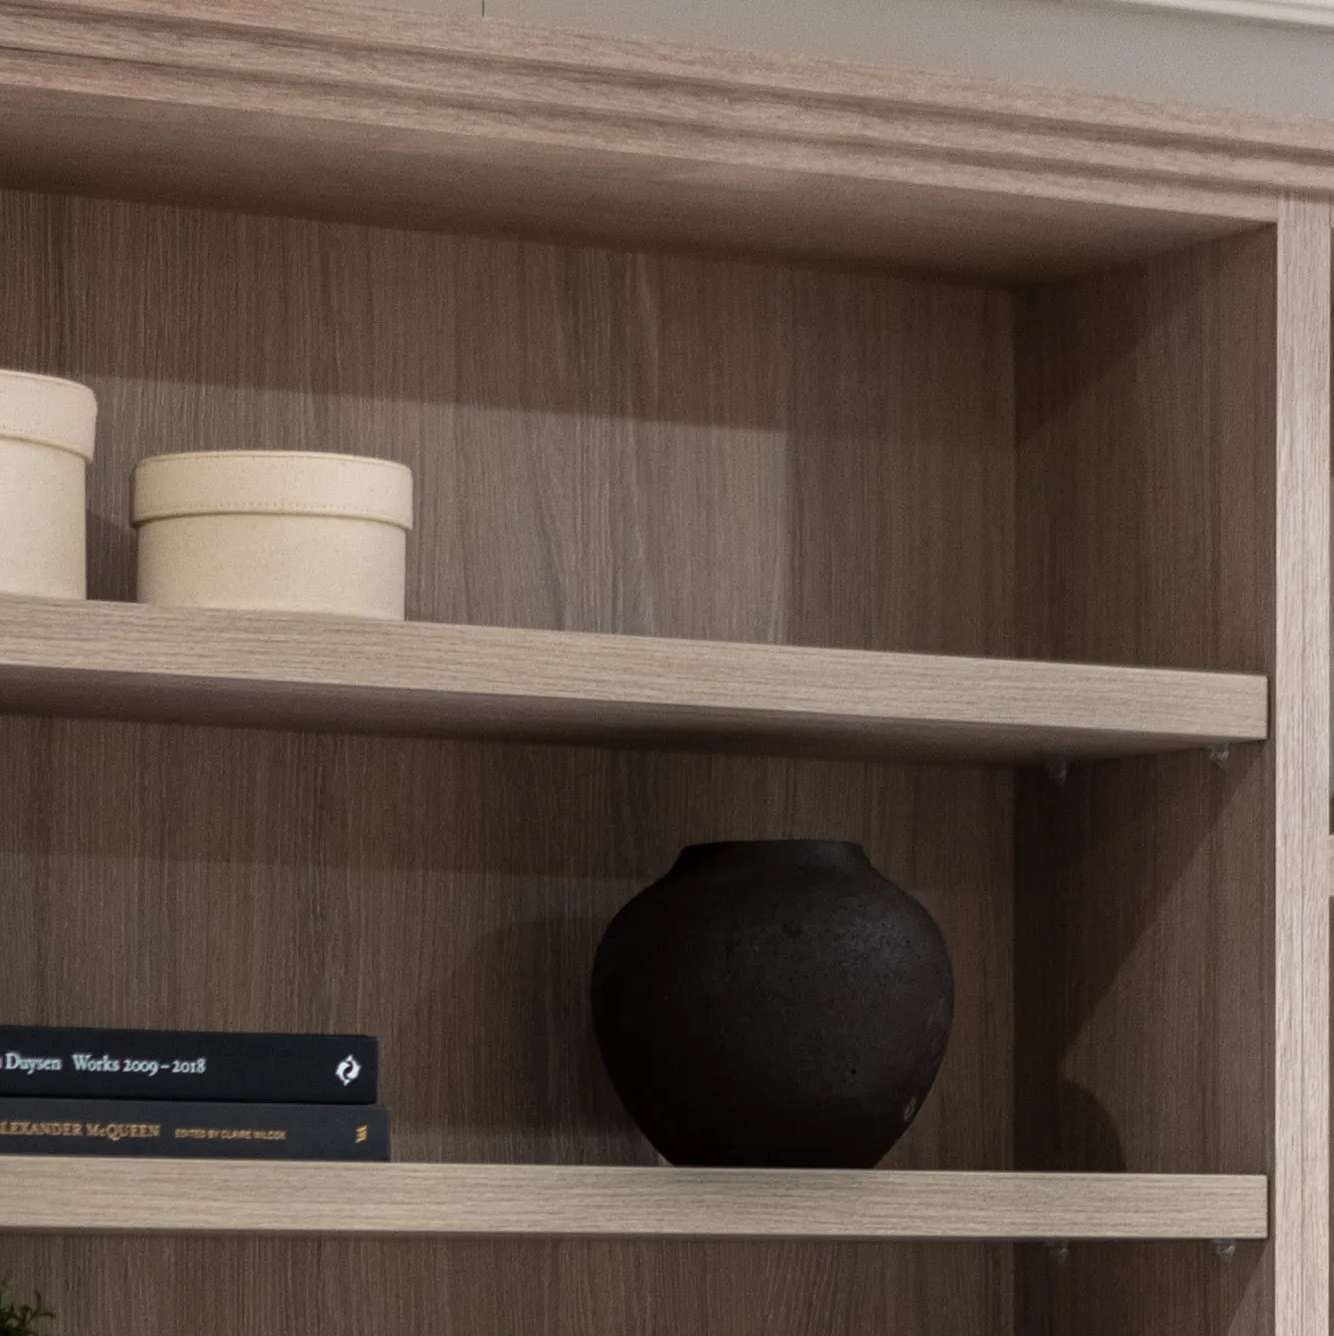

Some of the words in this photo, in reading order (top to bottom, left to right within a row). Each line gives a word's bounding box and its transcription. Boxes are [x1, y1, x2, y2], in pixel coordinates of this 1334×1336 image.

[5, 1053, 63, 1075] Duysen
[72, 1054, 120, 1072] Works
[122, 1058, 159, 1077] 2009
[171, 1057, 207, 1074] 2018
[85, 1122, 161, 1141] McQUEEN
[174, 1127, 206, 1139] EDITED
[207, 1128, 220, 1140] BY
[220, 1129, 253, 1140] CLAIRE
[253, 1129, 286, 1141] WILCOX
